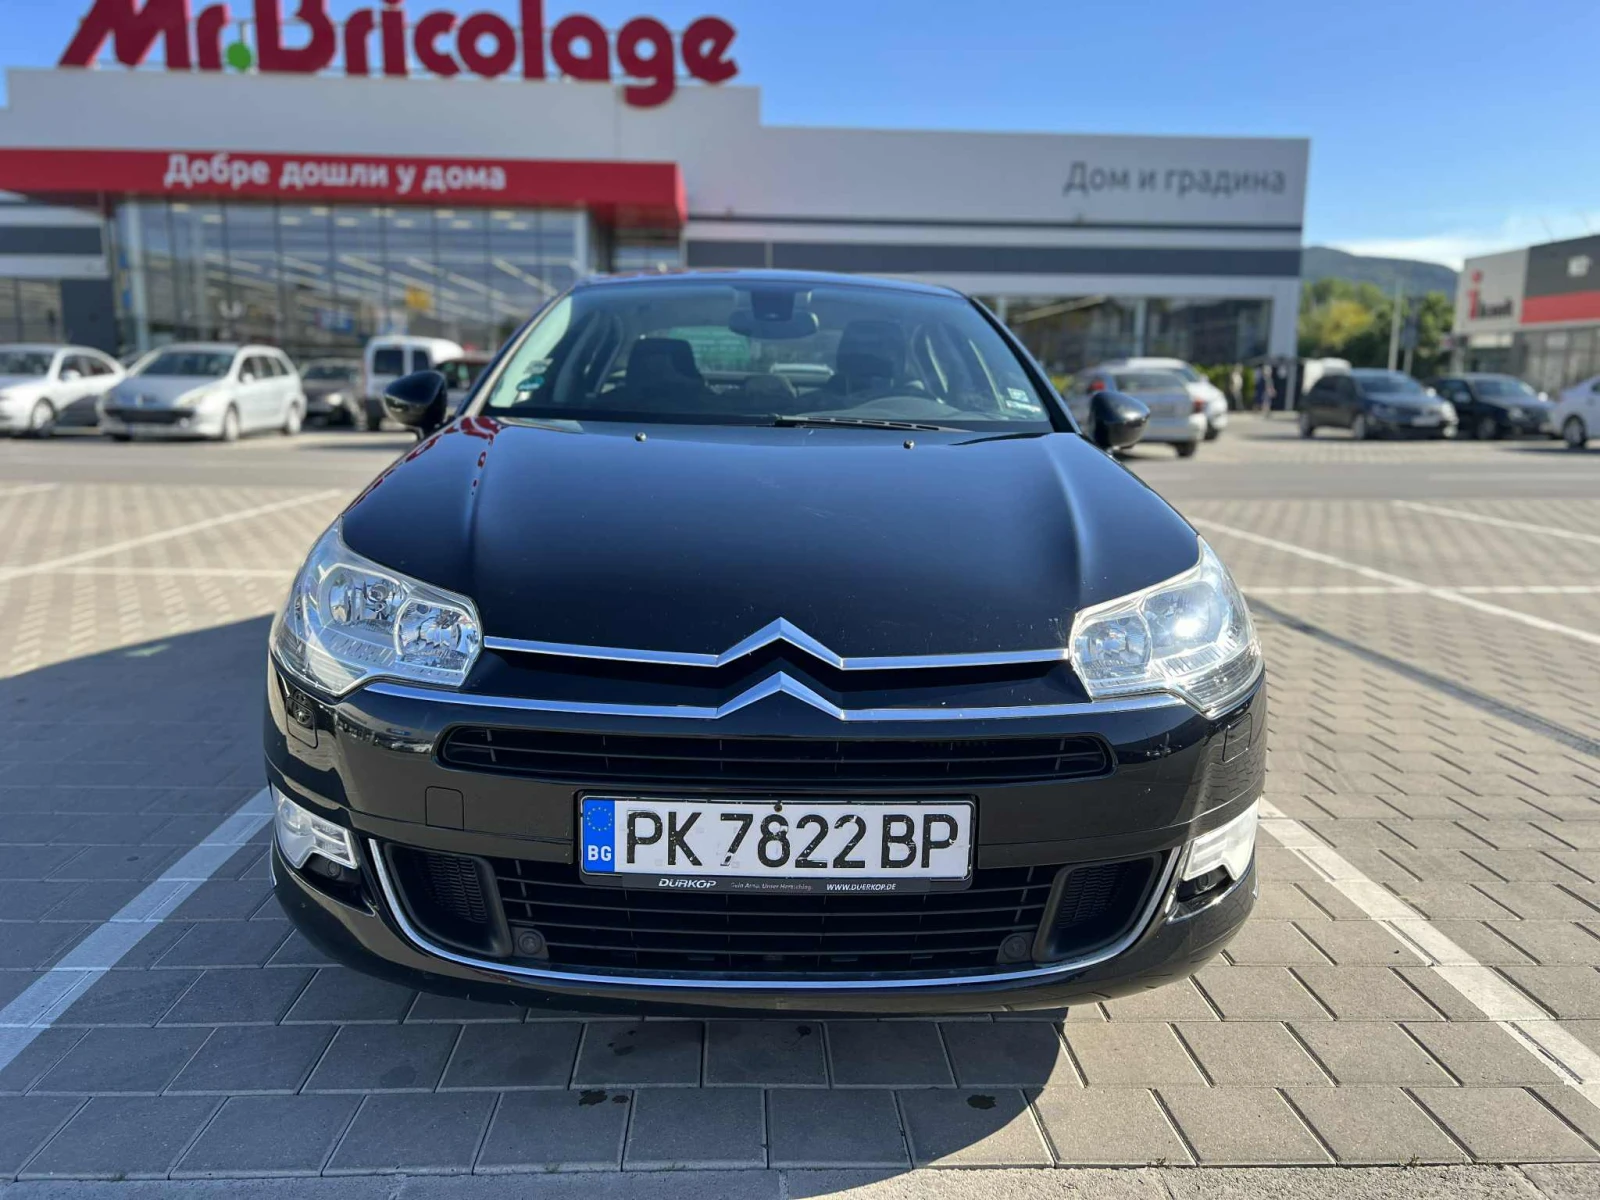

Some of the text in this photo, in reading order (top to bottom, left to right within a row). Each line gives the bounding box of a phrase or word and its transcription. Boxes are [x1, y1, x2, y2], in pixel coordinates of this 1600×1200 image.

[164, 152, 507, 194] Добре дошли у дома
[1062, 160, 1287, 199] Дом и градина
[587, 845, 612, 861] BG
[626, 810, 958, 868] PK 7822 BP
[826, 883, 897, 891] WWW.DUERKOP.DE
